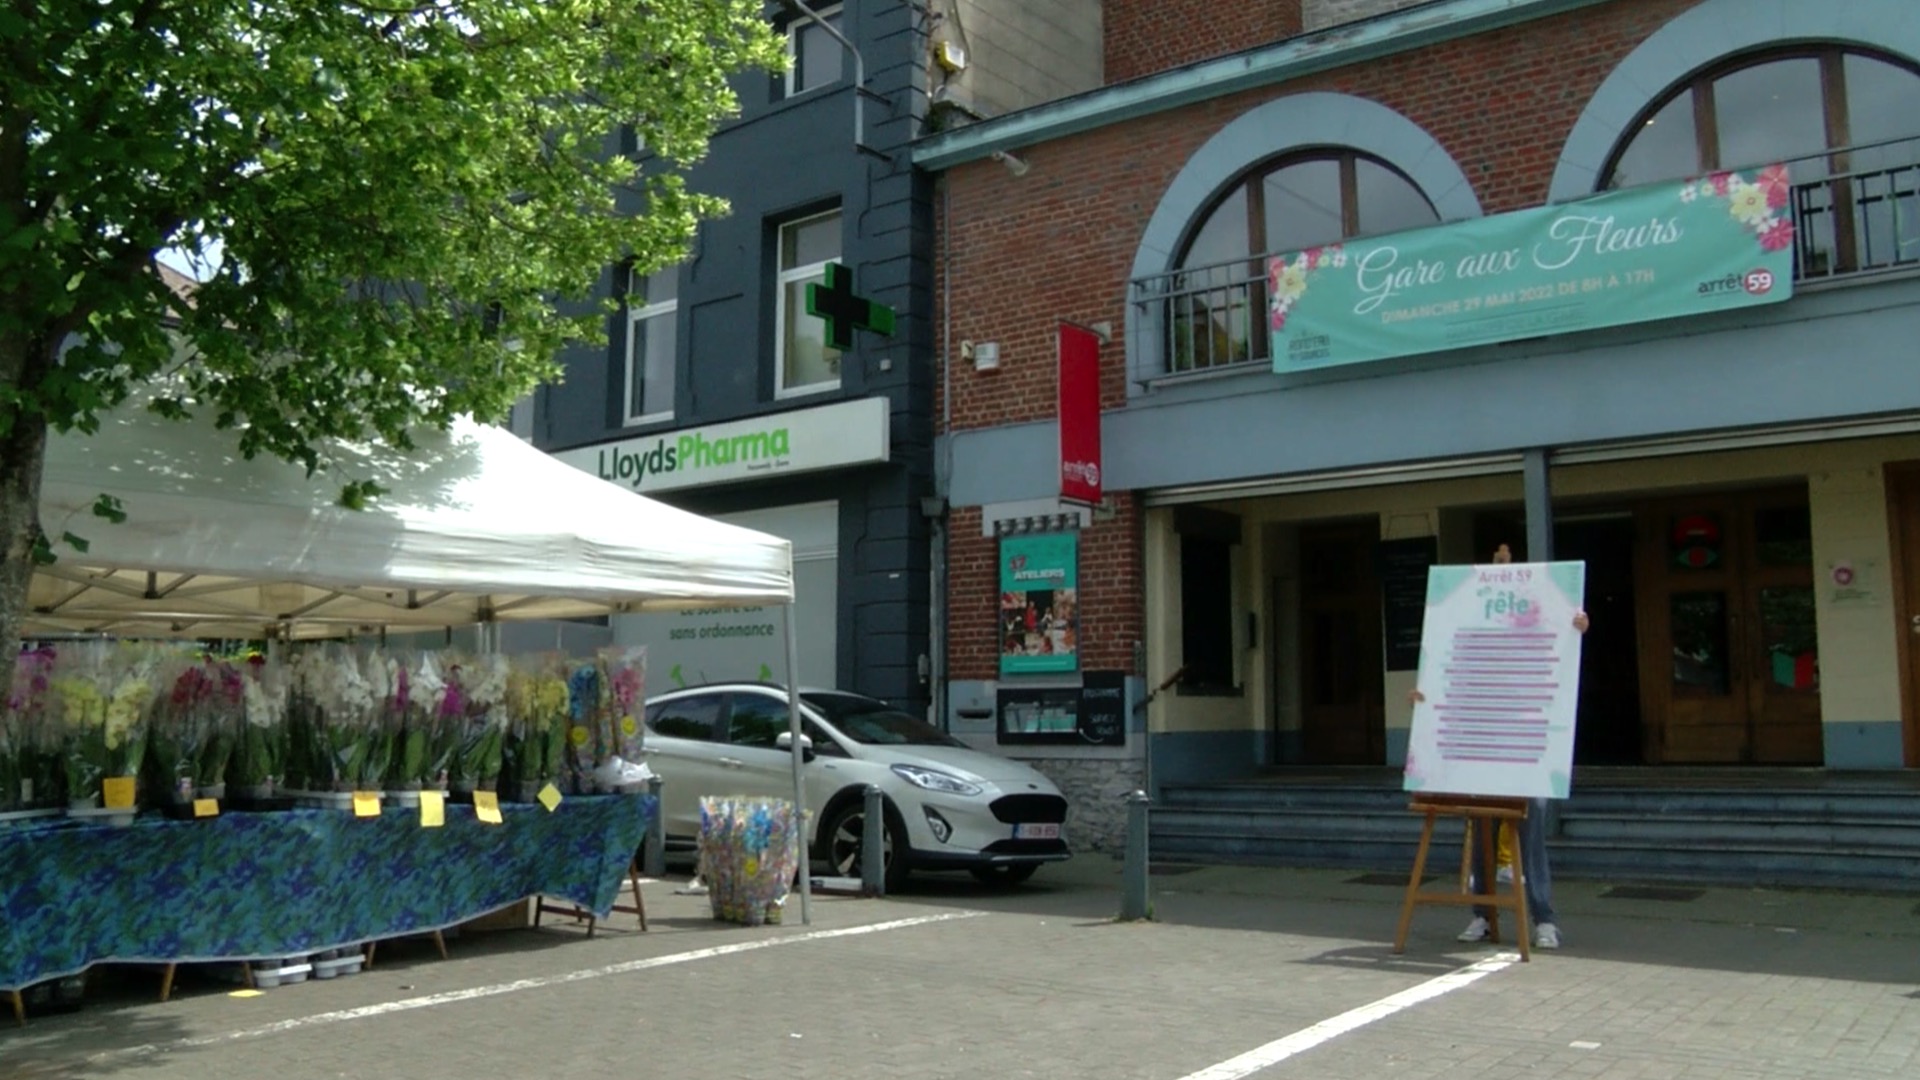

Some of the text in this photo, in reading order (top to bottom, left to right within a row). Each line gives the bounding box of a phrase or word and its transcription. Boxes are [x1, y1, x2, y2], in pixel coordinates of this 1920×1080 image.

[1353, 215, 1683, 314] Gare aux Fleurs
[1698, 272, 1772, 293] arrêt 59
[1381, 300, 1461, 324] DIMANCHE
[1484, 292, 1515, 308] MAI
[1558, 280, 1577, 296] DE
[1624, 267, 1655, 284] 17H
[598, 428, 790, 487] LloydsPharma
[669, 623, 774, 640] sans ordonnance
